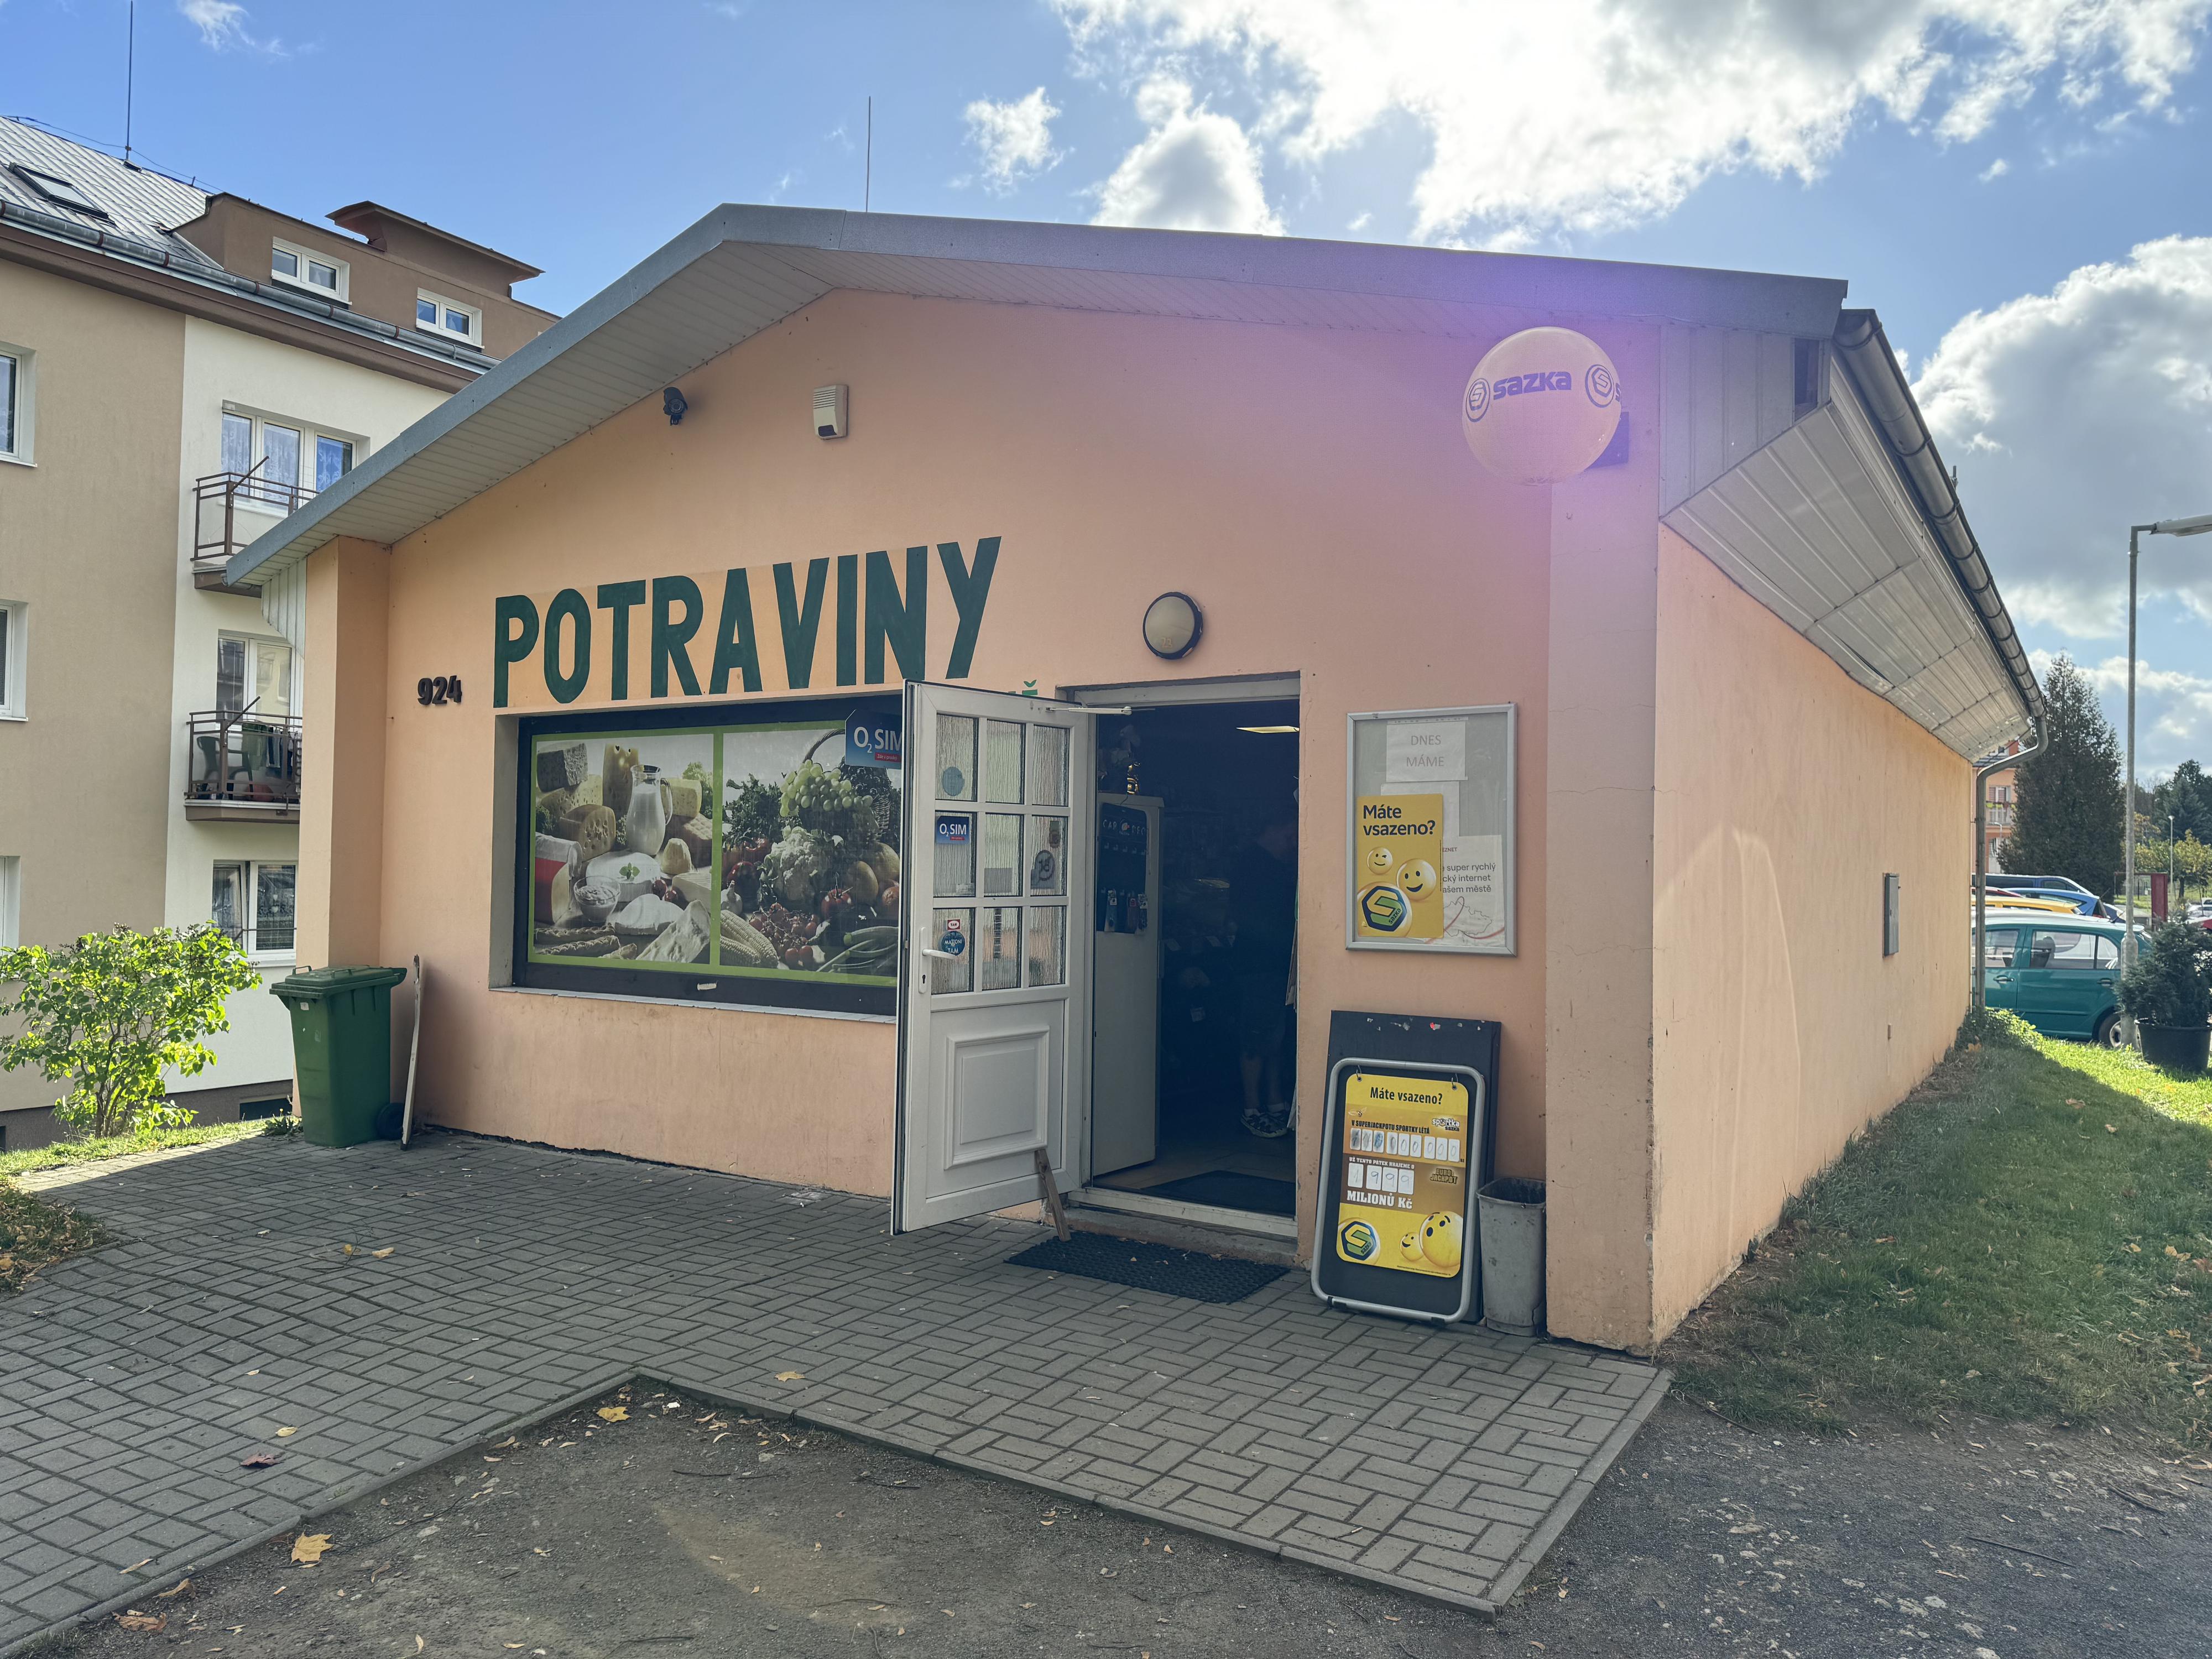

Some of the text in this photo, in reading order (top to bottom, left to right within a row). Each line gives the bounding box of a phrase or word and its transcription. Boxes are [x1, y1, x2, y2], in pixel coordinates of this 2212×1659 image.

[1493, 371, 1572, 400] sazka
[493, 536, 1002, 708] POTRAVINY
[418, 675, 462, 705] 924
[874, 729, 902, 751] SIM
[1411, 735, 1442, 745] DNES
[1406, 754, 1444, 766] MÁME
[1363, 804, 1402, 819] Máte
[950, 823, 967, 835] SIM
[1363, 820, 1436, 836] vsazeno?
[1472, 863, 1496, 872] rychlý
[1370, 1087, 1443, 1105] Máte vsazeno?
[1355, 1120, 1395, 1131] SUPERJACKPOTU
[1396, 1125, 1418, 1133] SPORTKY
[1347, 1191, 1412, 1209] MILIONŮ Kč
